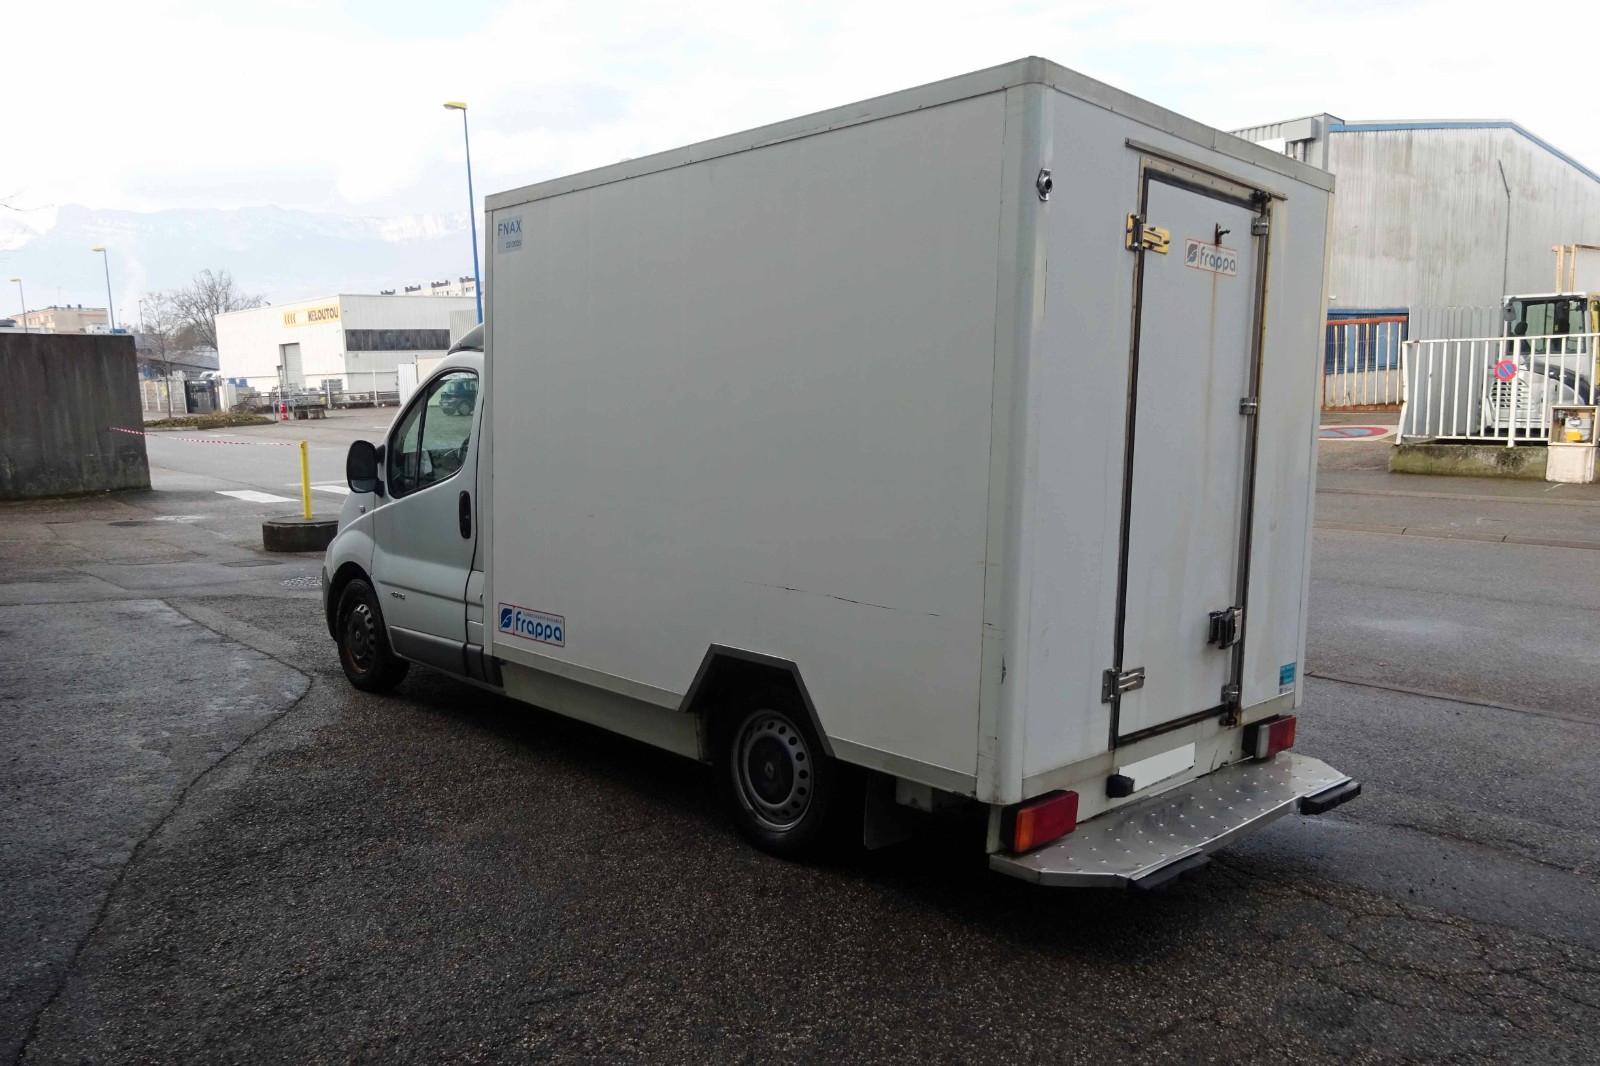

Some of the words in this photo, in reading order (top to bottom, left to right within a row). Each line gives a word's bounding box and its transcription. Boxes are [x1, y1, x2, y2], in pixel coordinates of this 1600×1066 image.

[498, 219, 522, 236] FNAX
[1200, 246, 1236, 273] frappa
[515, 610, 562, 642] frappa
